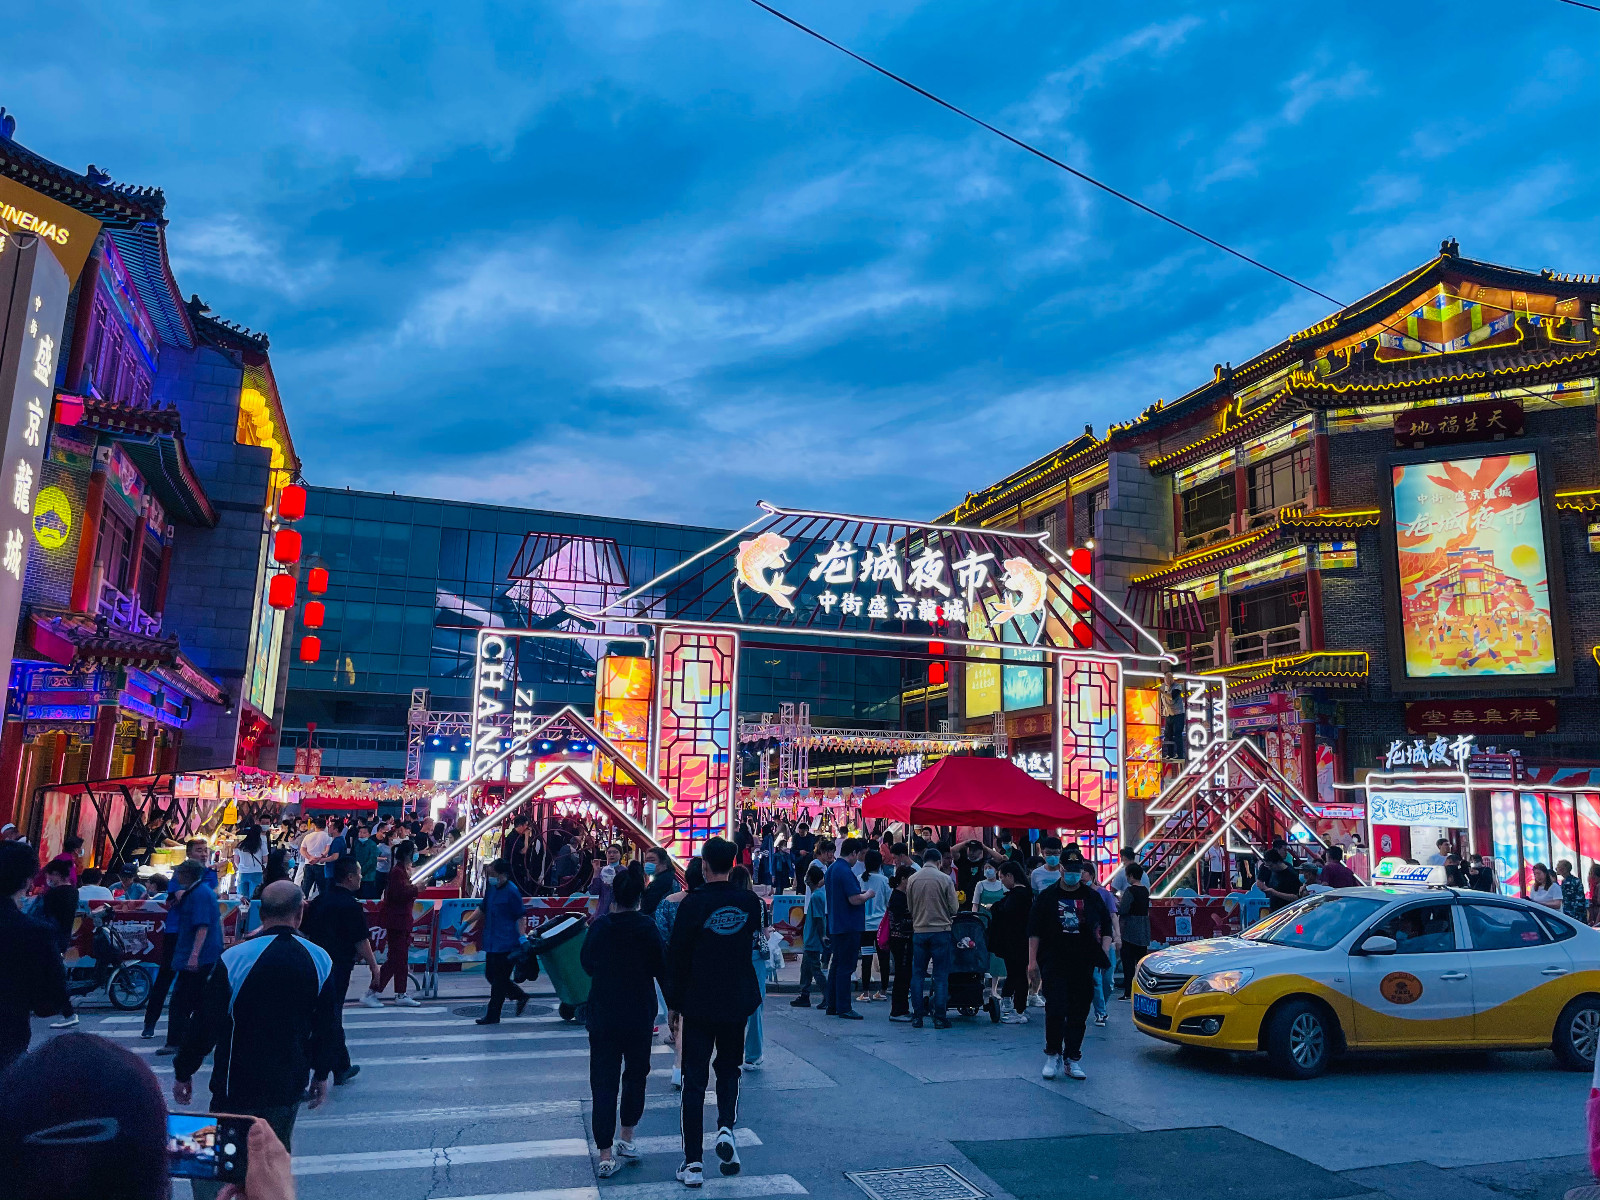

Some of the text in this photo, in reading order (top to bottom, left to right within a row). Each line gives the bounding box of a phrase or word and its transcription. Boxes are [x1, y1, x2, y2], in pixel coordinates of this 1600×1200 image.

[809, 540, 997, 604] 龙城夜市
[1385, 734, 1476, 773] 龙城夜市
